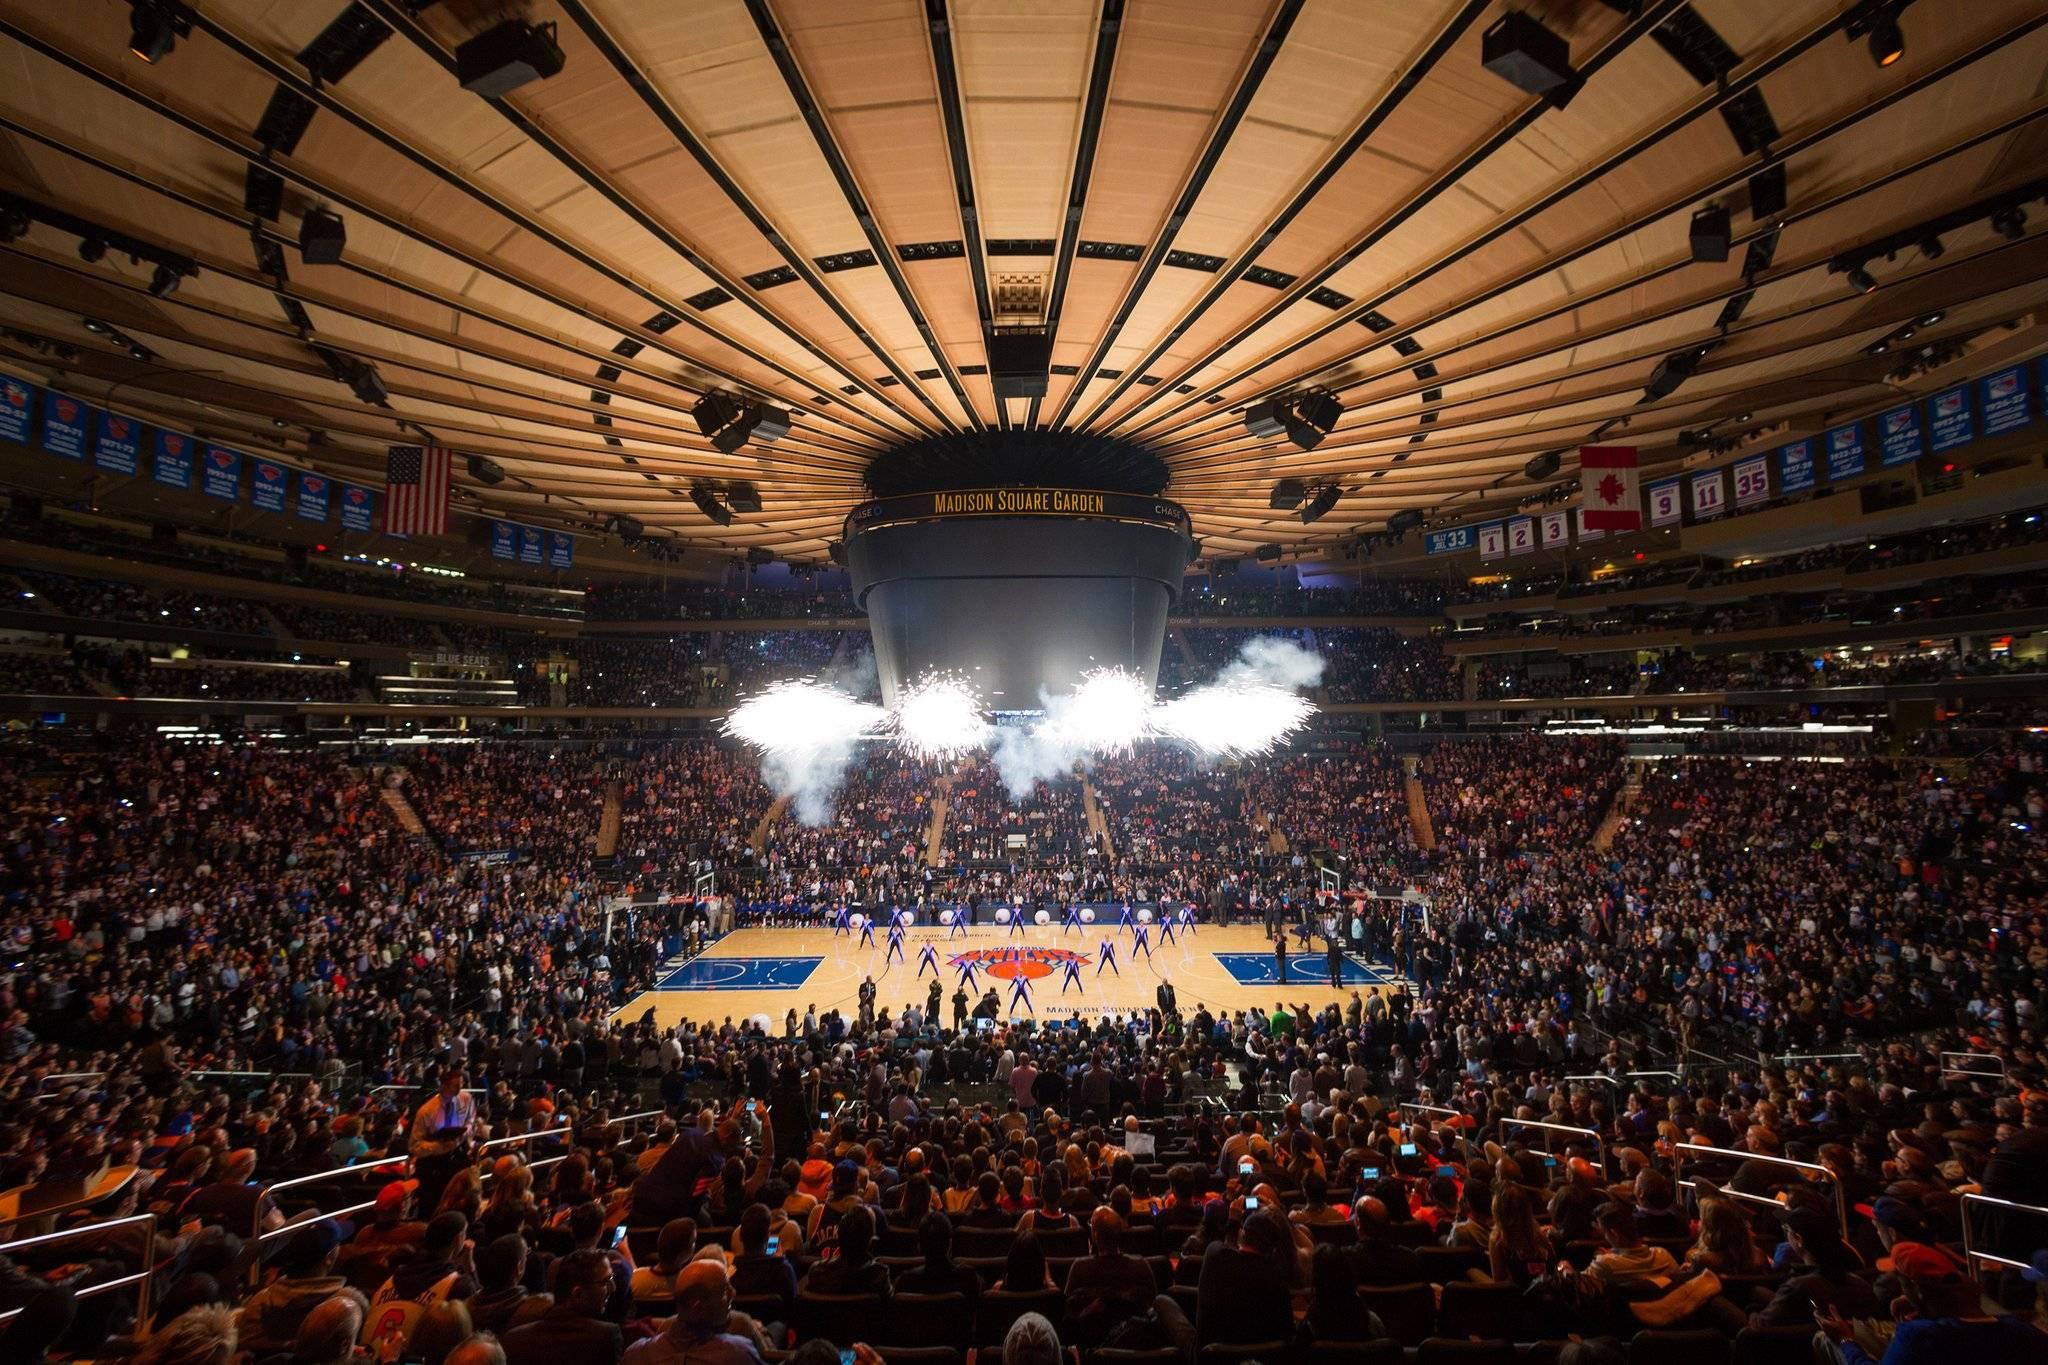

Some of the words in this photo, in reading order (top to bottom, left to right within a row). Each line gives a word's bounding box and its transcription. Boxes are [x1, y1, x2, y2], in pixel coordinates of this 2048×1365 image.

[1737, 471, 1766, 496] 35
[935, 493, 993, 513] MADISON
[998, 490, 1049, 511] SQUARE
[1054, 491, 1104, 512] GARDEN
[1698, 485, 1717, 508] 11
[1659, 496, 1671, 515] 9
[1447, 530, 1467, 547] 33
[1515, 530, 1526, 546] 2
[1549, 522, 1560, 539] 3
[1488, 536, 1495, 552] 1
[436, 653, 460, 664] BLUE
[463, 655, 490, 666] SEATS
